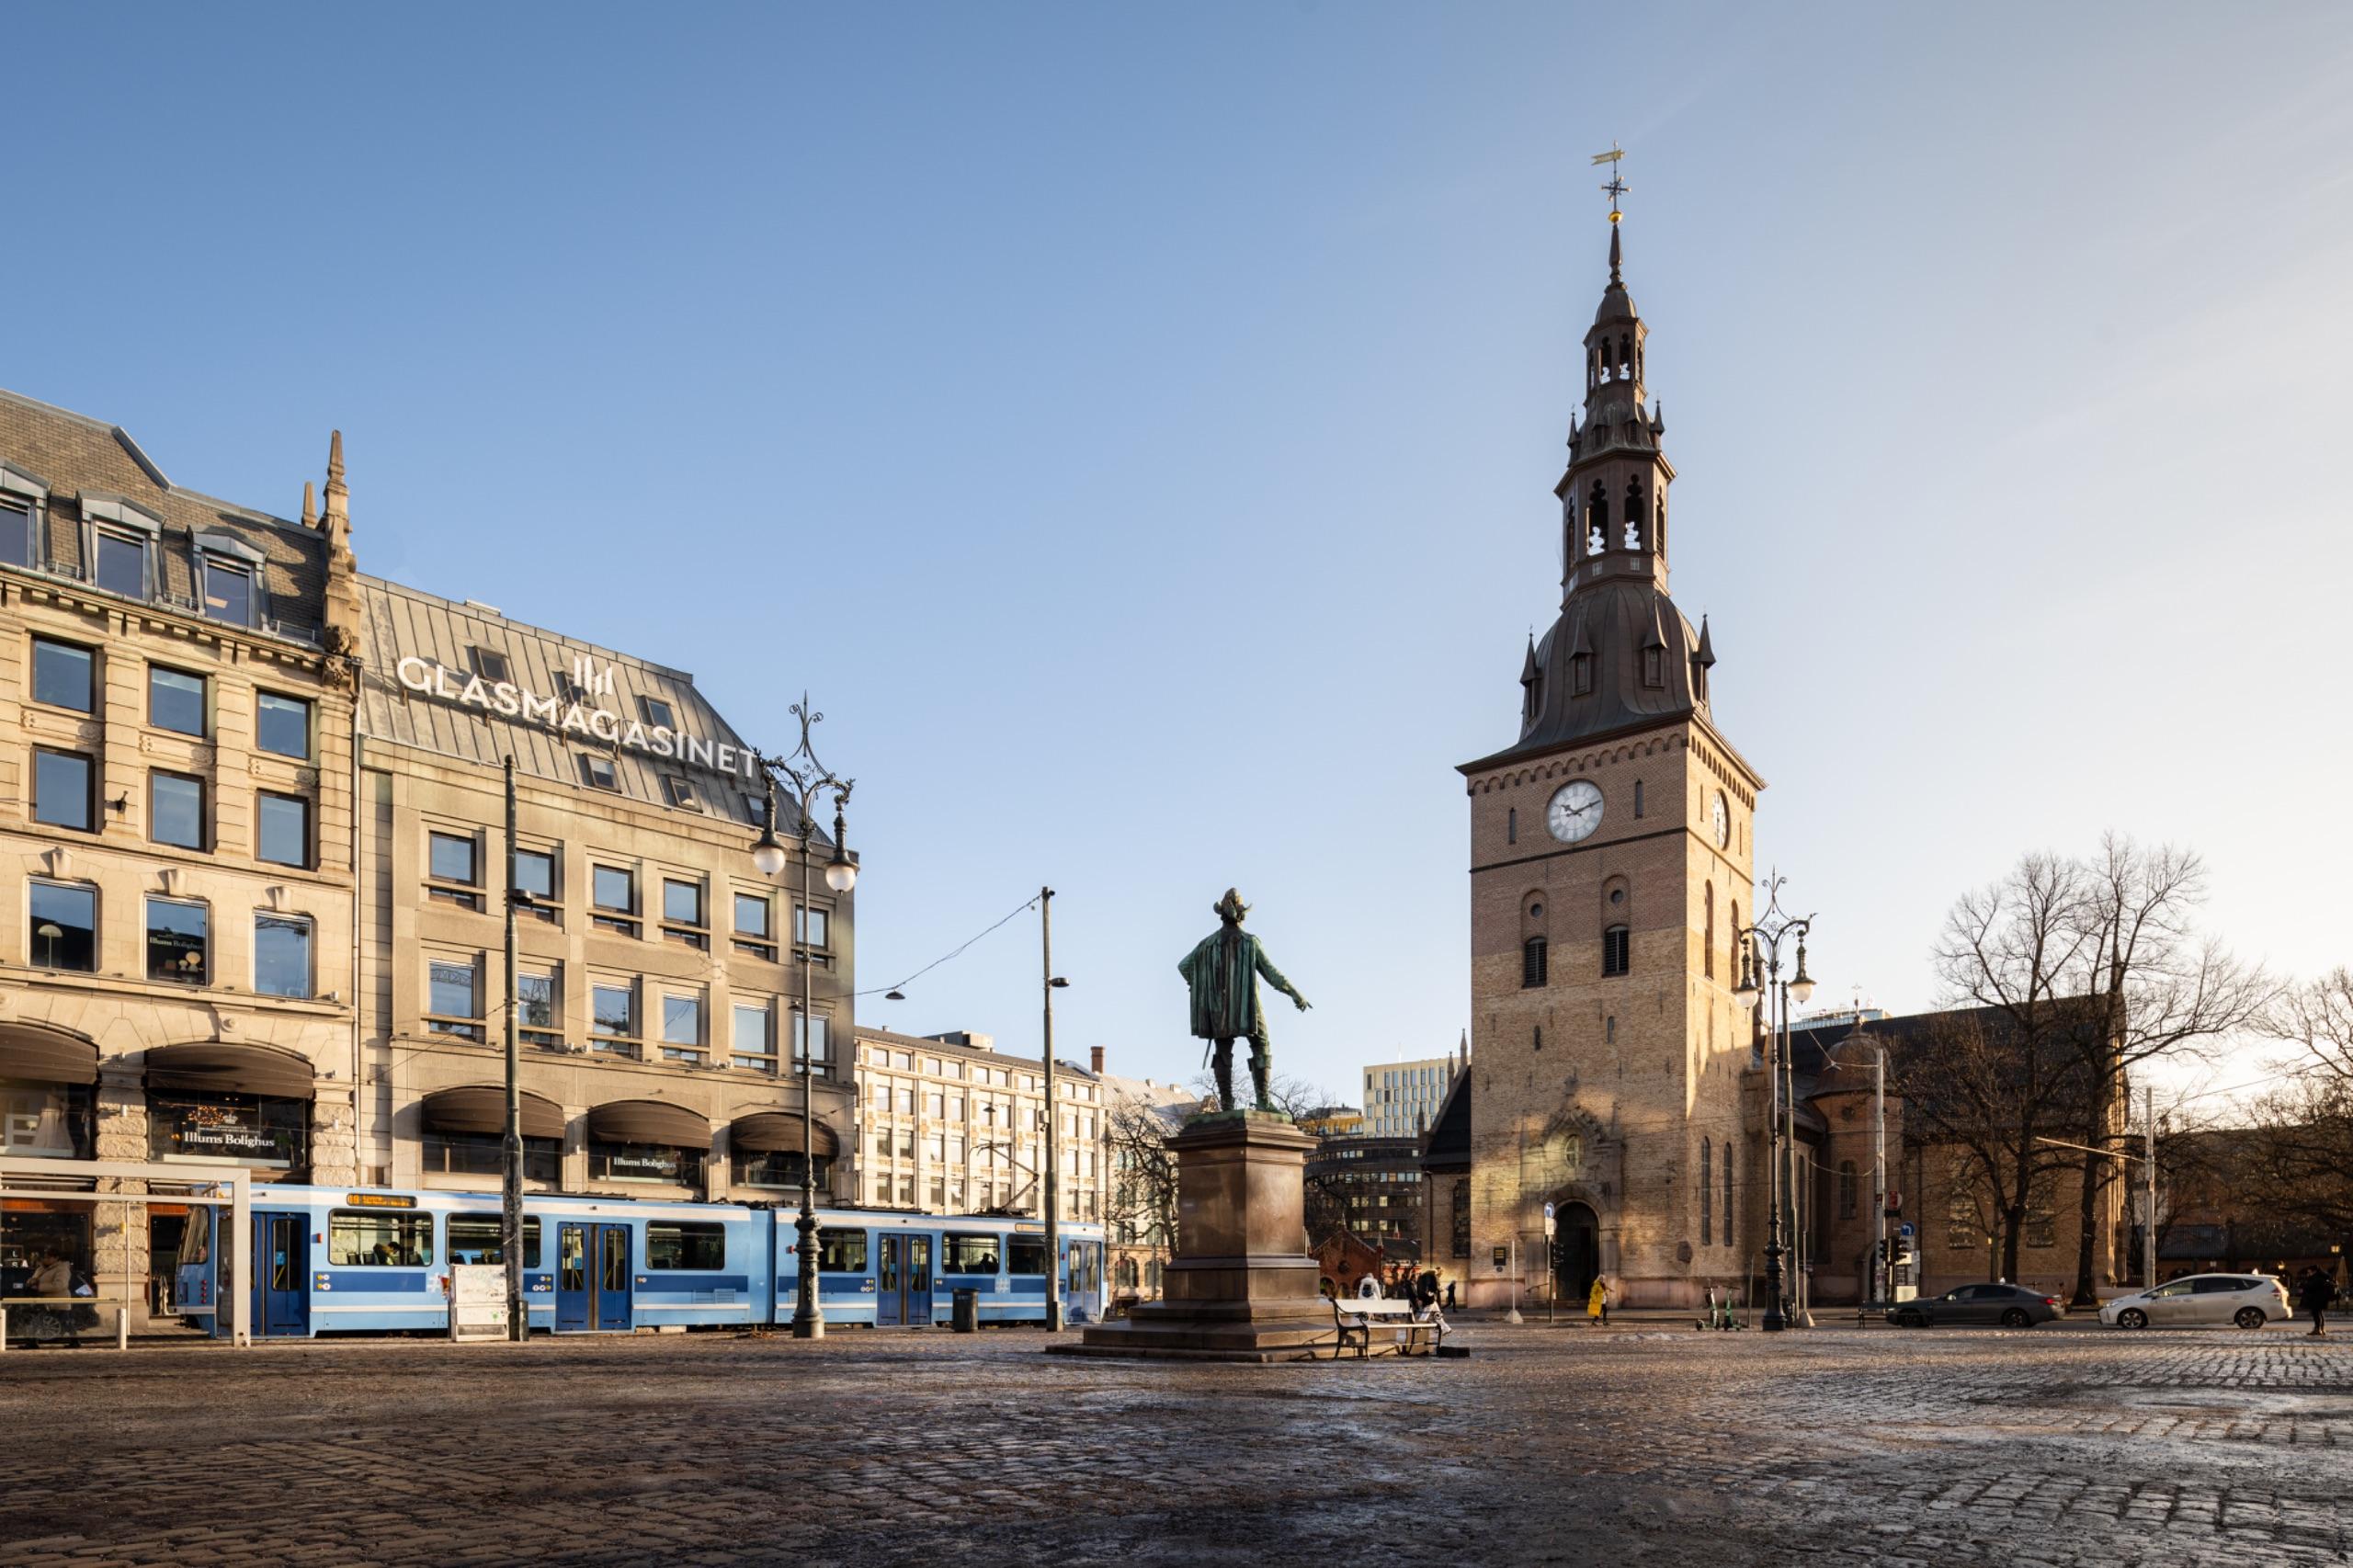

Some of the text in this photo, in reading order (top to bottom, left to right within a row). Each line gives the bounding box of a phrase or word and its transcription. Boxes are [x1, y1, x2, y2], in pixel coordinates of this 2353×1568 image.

[397, 656, 756, 778] GLASMAGASINET
[184, 1131, 275, 1148] Illums Bolighus
[613, 1156, 676, 1170] Illums Bolighus
